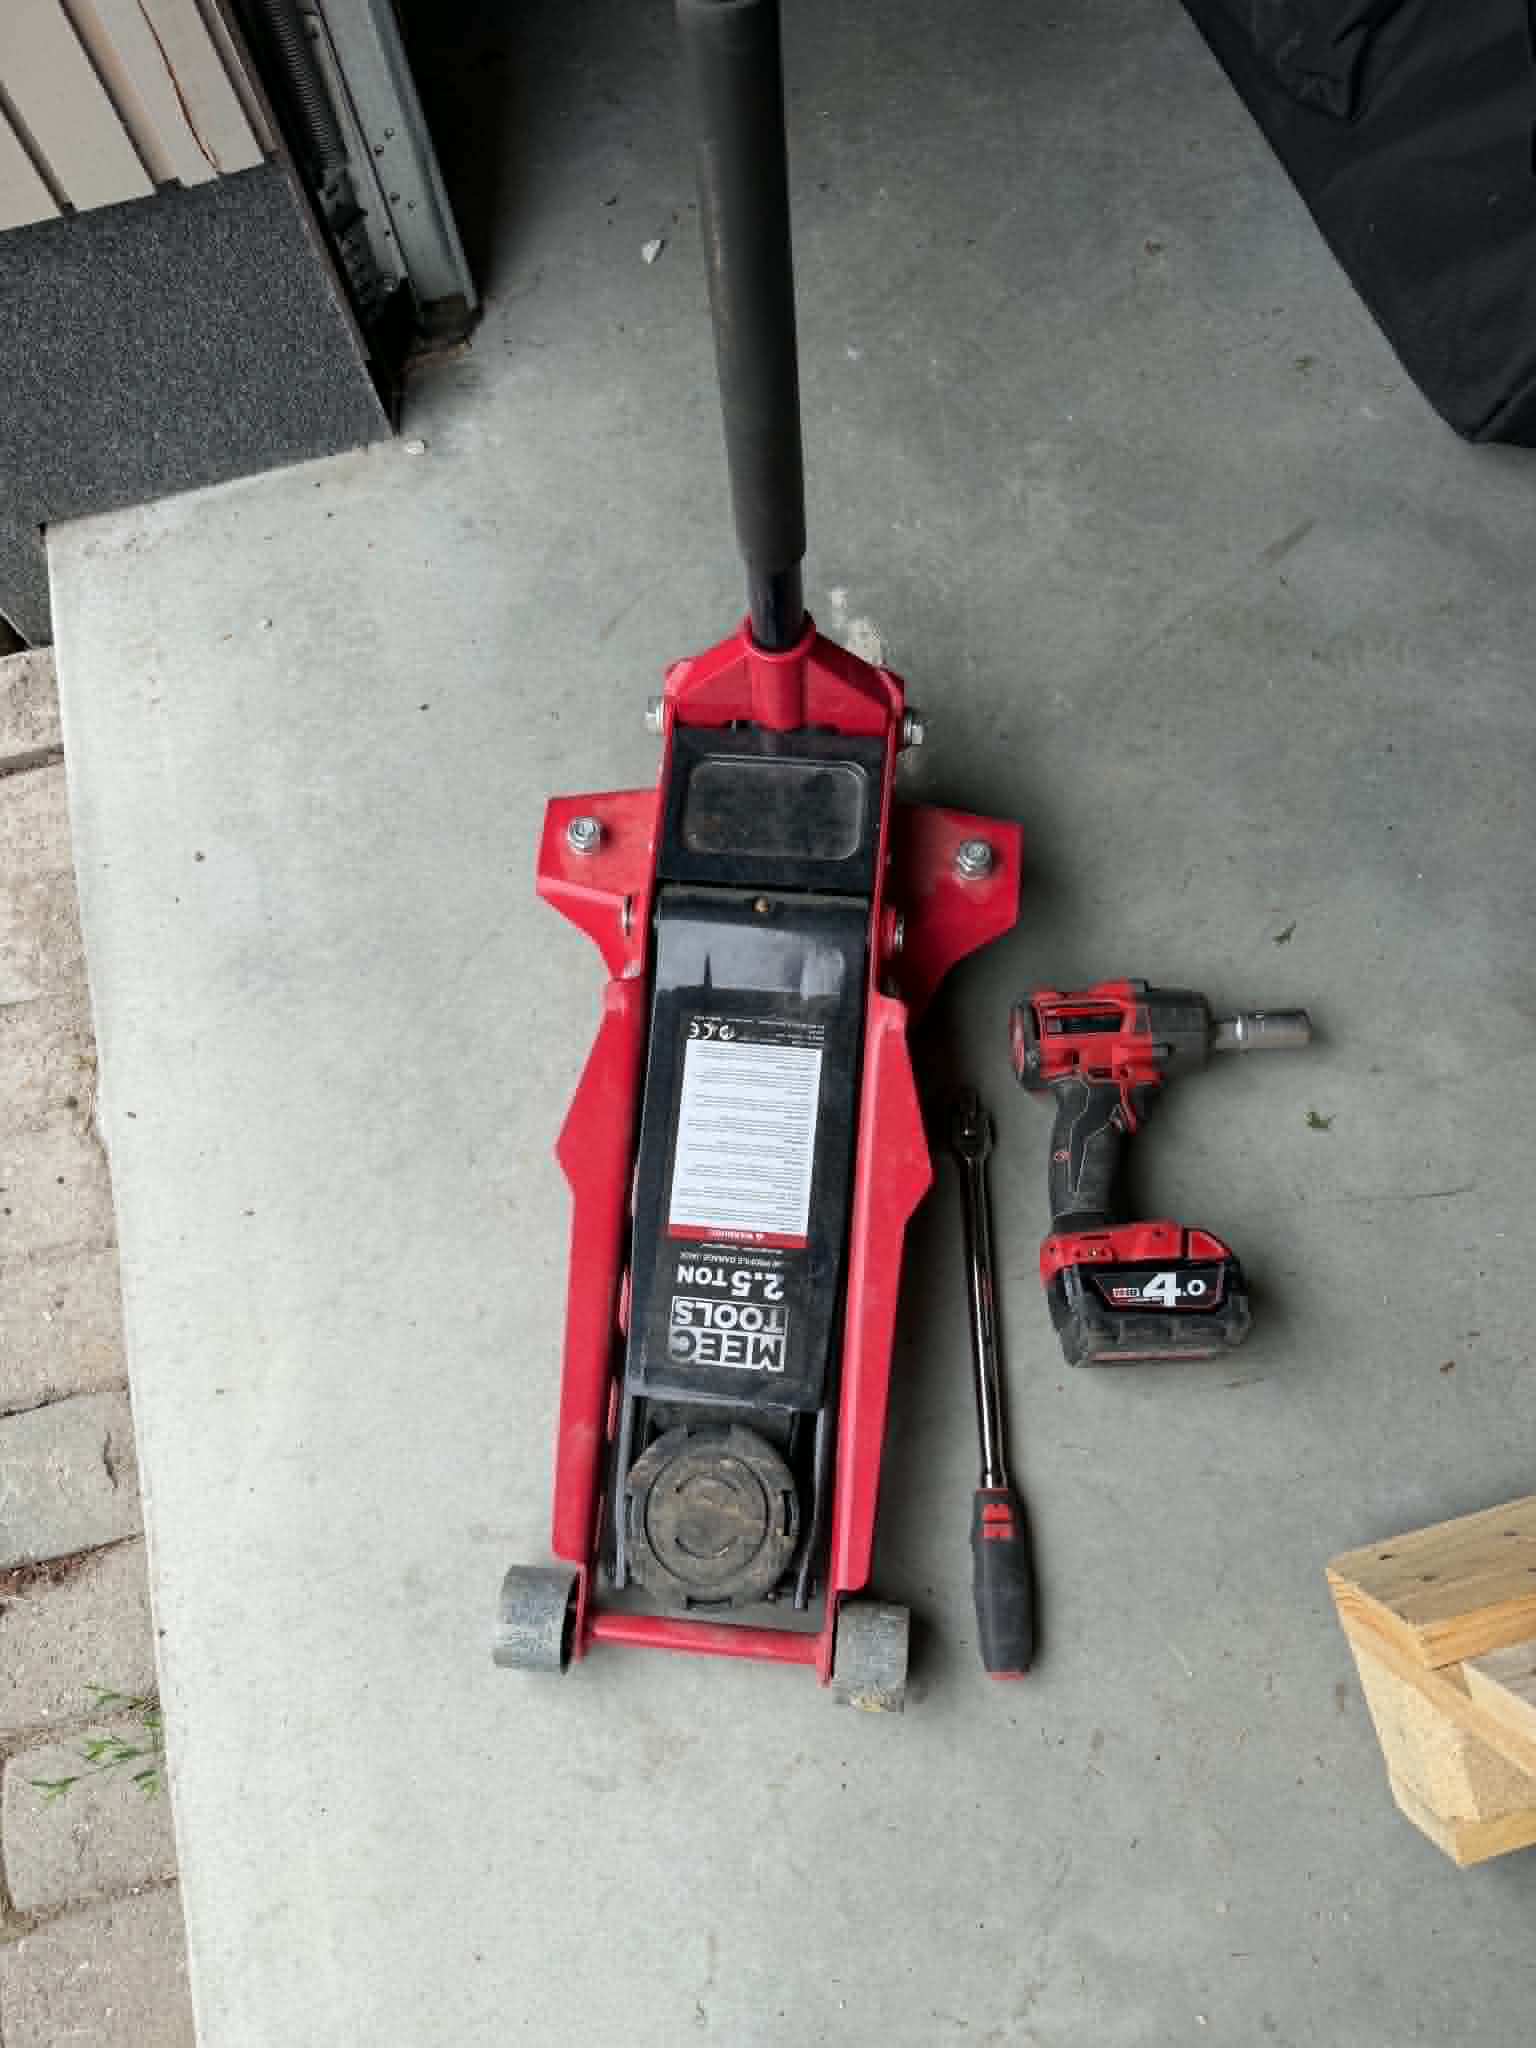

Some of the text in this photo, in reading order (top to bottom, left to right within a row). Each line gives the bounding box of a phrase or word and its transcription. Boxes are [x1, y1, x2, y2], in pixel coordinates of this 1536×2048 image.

[677, 1264, 785, 1300] 2.5 TON
[1142, 1272, 1207, 1307] 4.0
[675, 1300, 784, 1334] TOOLS
[671, 1329, 783, 1369] MEEC
